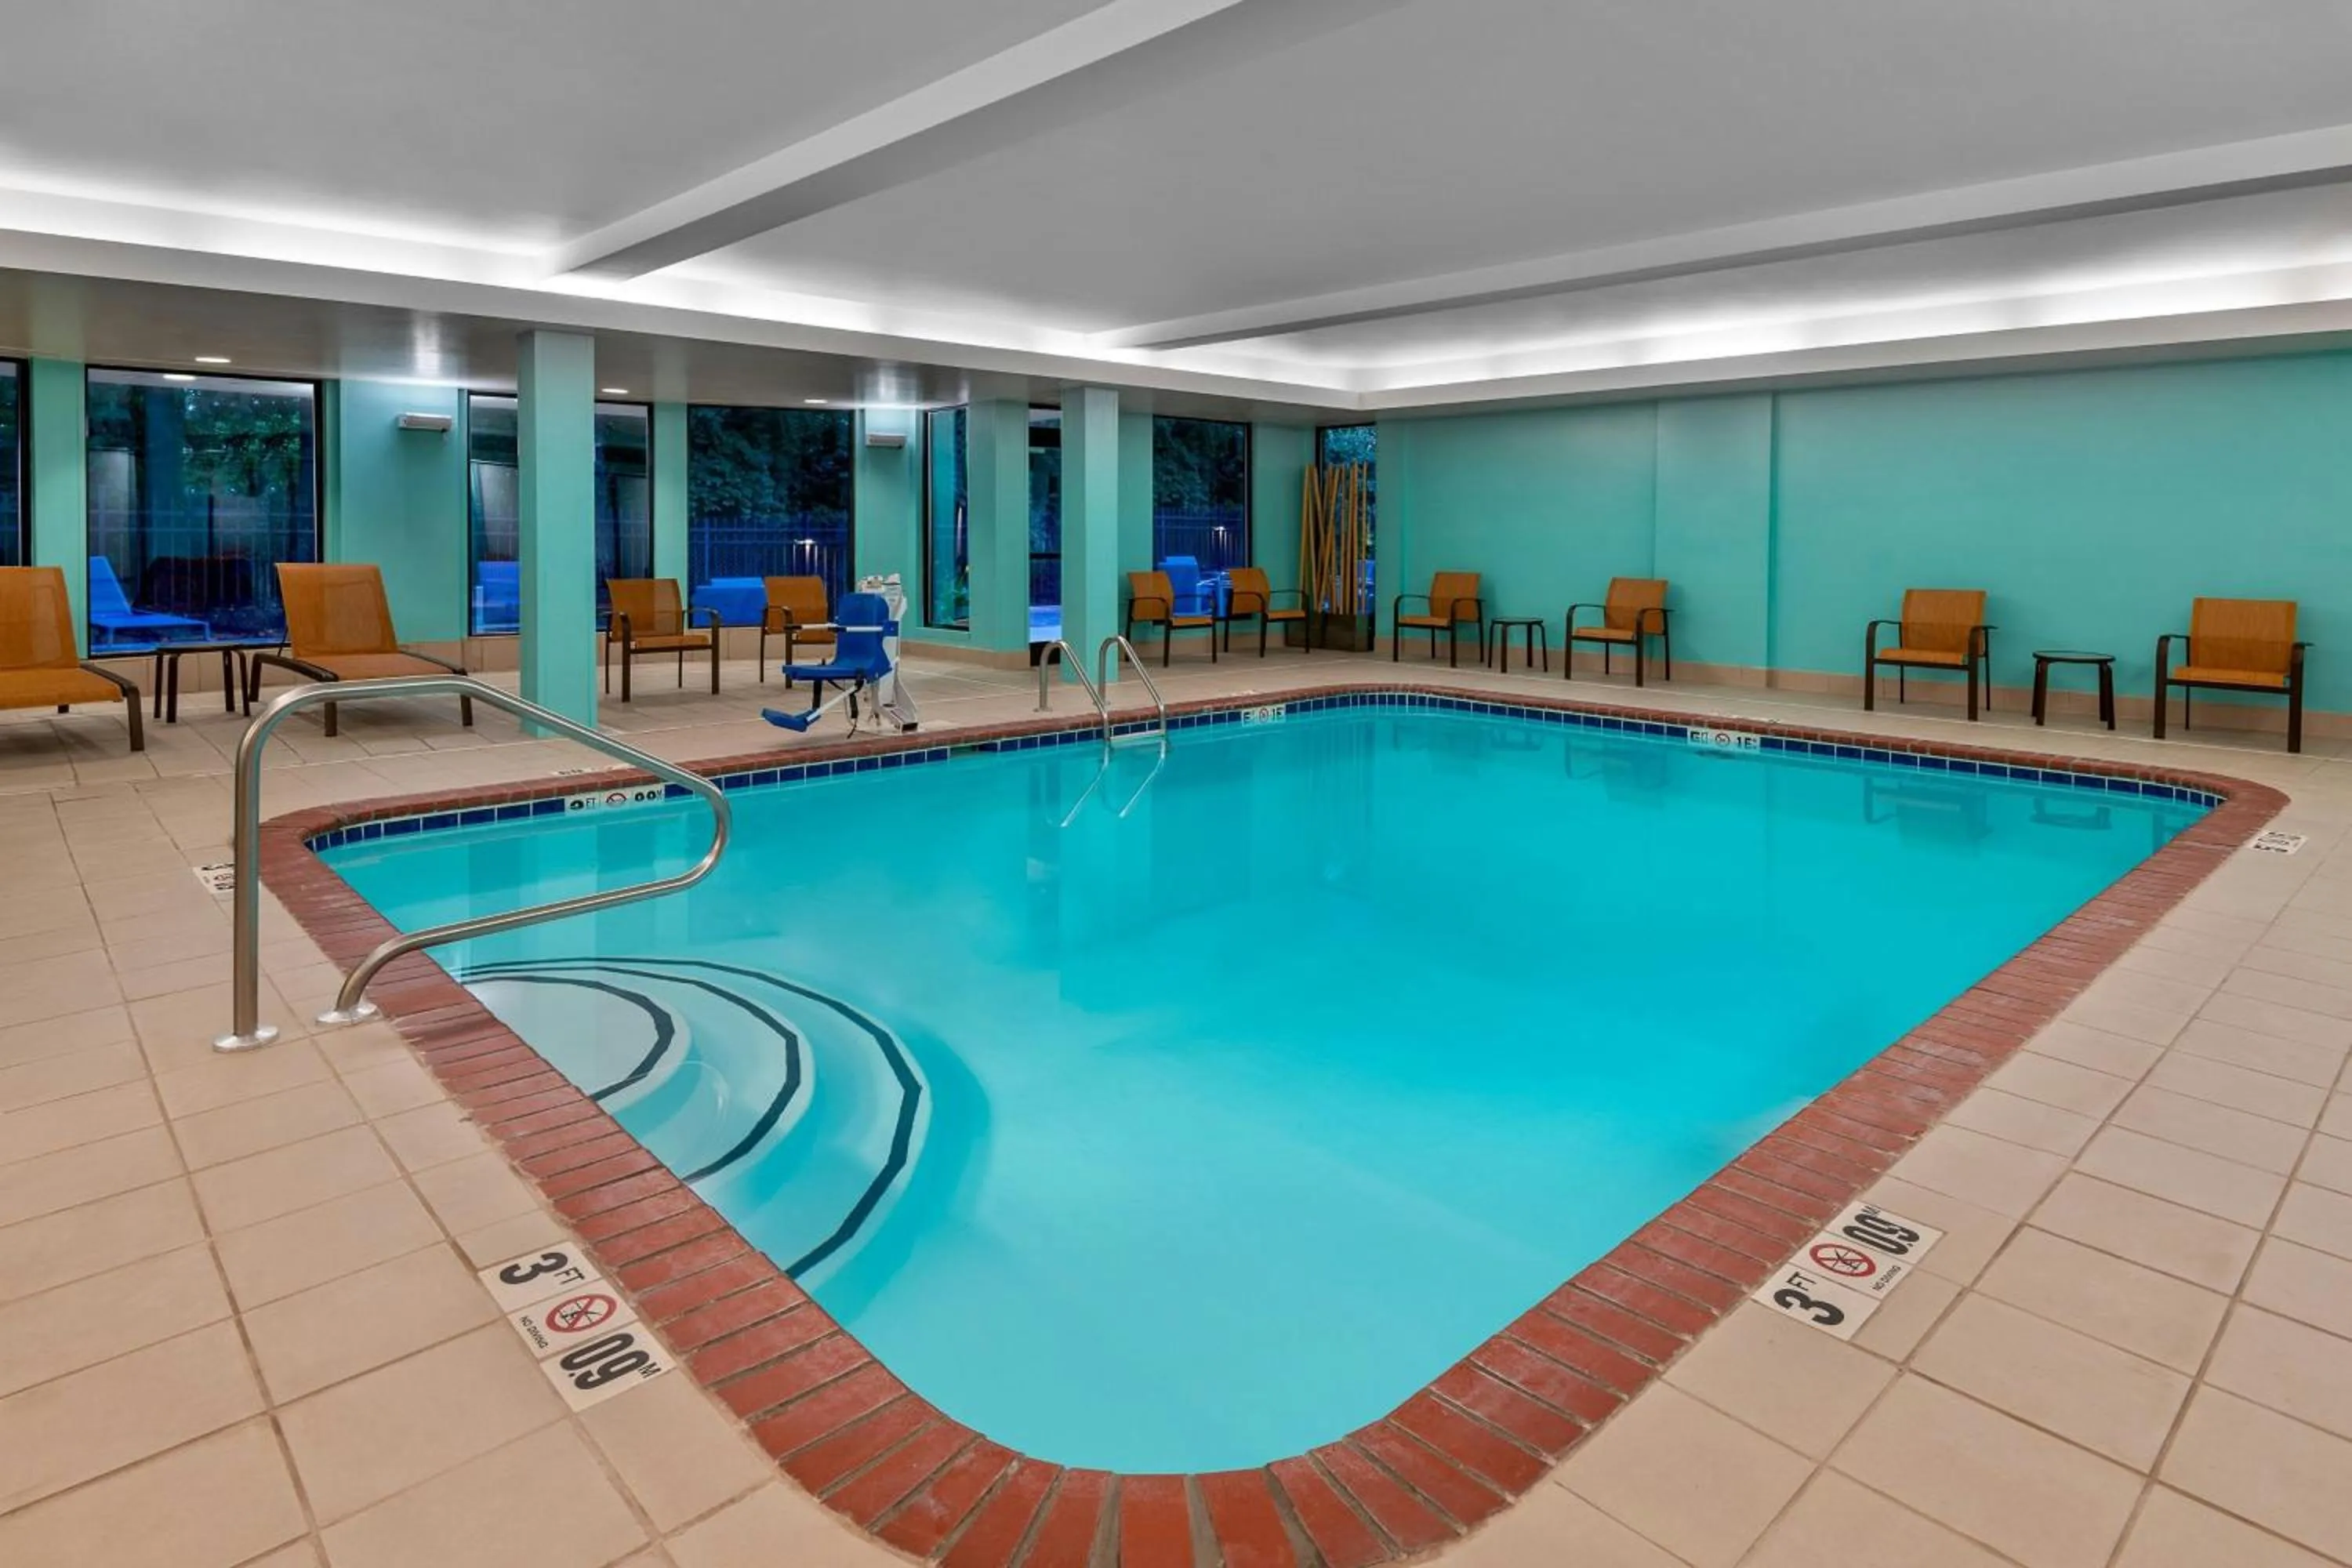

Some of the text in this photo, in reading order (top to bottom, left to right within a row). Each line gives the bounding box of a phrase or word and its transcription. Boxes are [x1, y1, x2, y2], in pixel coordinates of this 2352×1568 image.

[1842, 1213, 1920, 1255] 0.9
[499, 1252, 586, 1286] 3 FT
[1773, 1271, 1845, 1326] 3 FT
[519, 1315, 534, 1328] NO
[560, 1333, 650, 1390] 0.9
